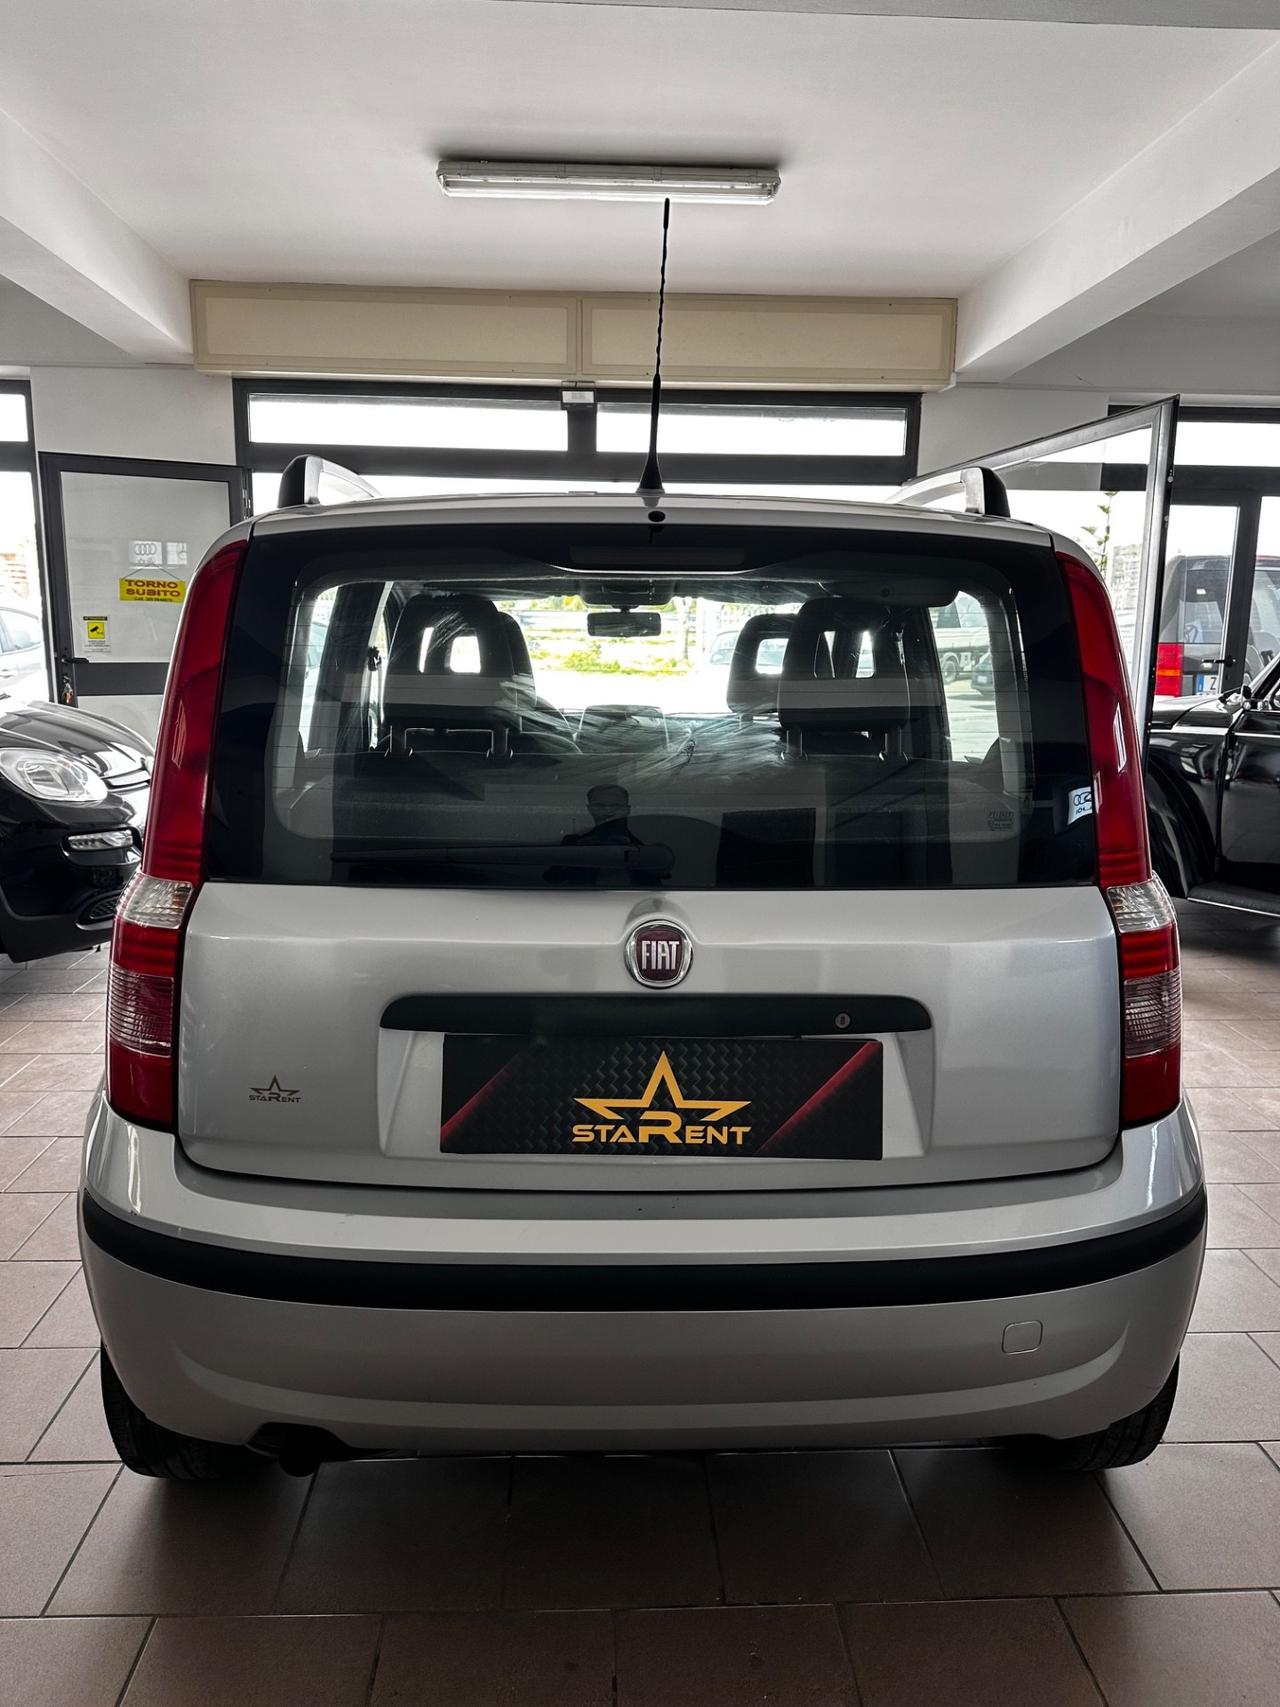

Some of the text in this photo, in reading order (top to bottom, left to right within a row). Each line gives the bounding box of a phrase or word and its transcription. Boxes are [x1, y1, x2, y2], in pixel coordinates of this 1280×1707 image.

[125, 579, 178, 589] TORNO
[126, 588, 181, 598] SUBITO
[641, 940, 680, 970] FIAT
